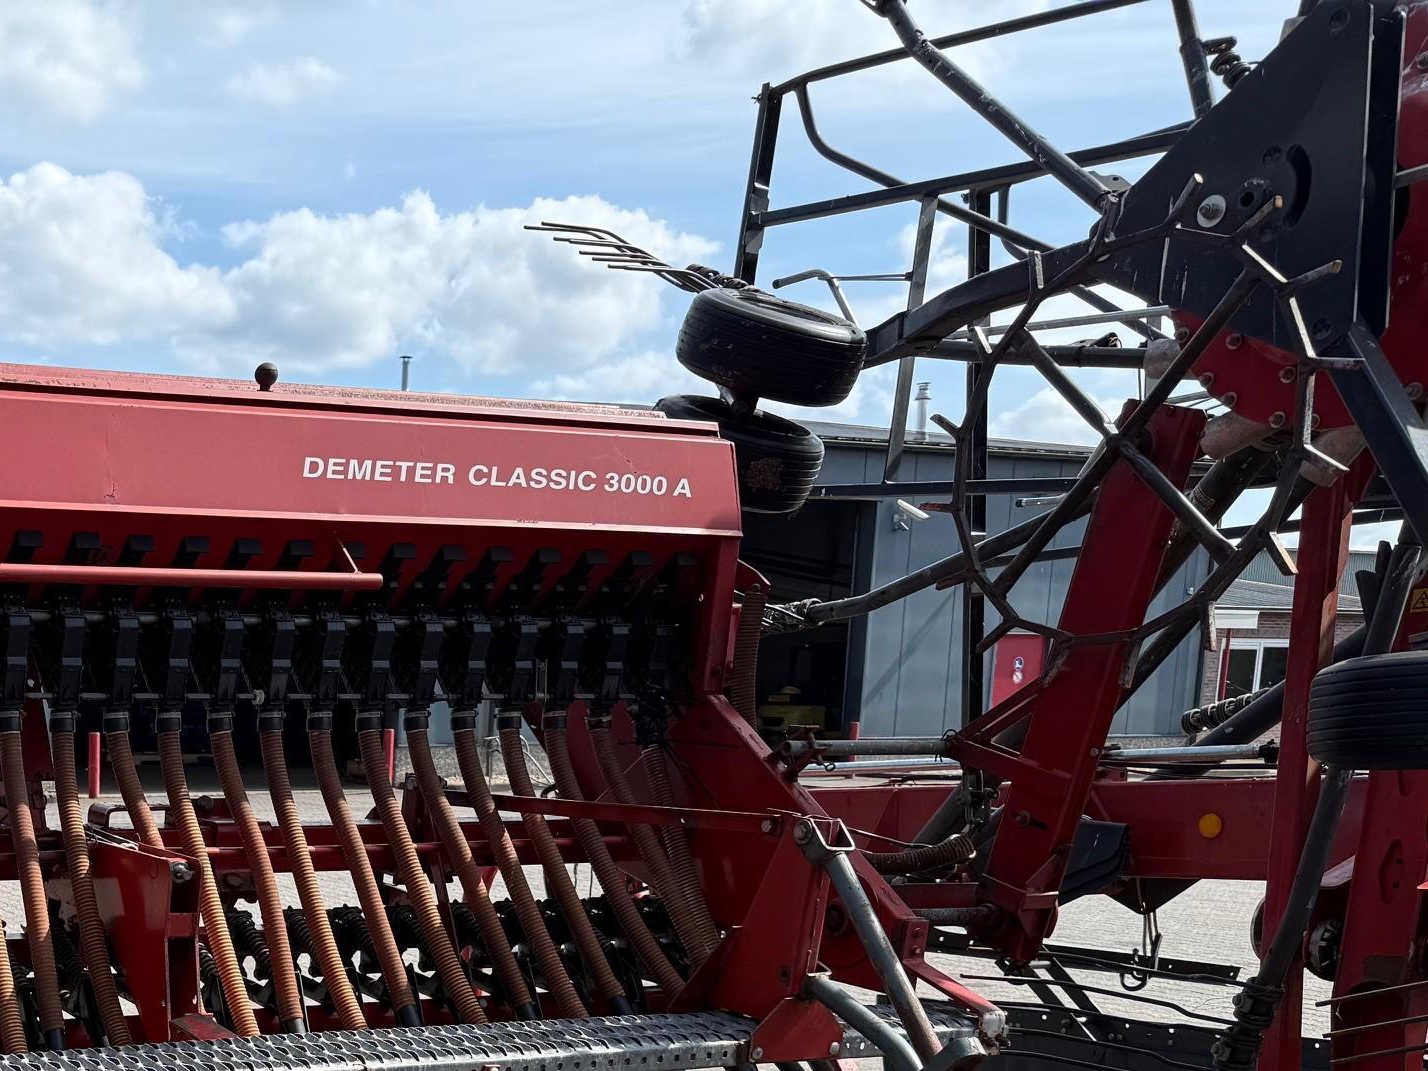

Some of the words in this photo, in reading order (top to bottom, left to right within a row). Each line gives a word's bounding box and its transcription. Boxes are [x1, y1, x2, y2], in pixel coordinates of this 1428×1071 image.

[302, 456, 457, 485] DEMETER
[468, 464, 597, 491] CLASSIC
[603, 472, 668, 496] 3000
[672, 478, 692, 498] A
